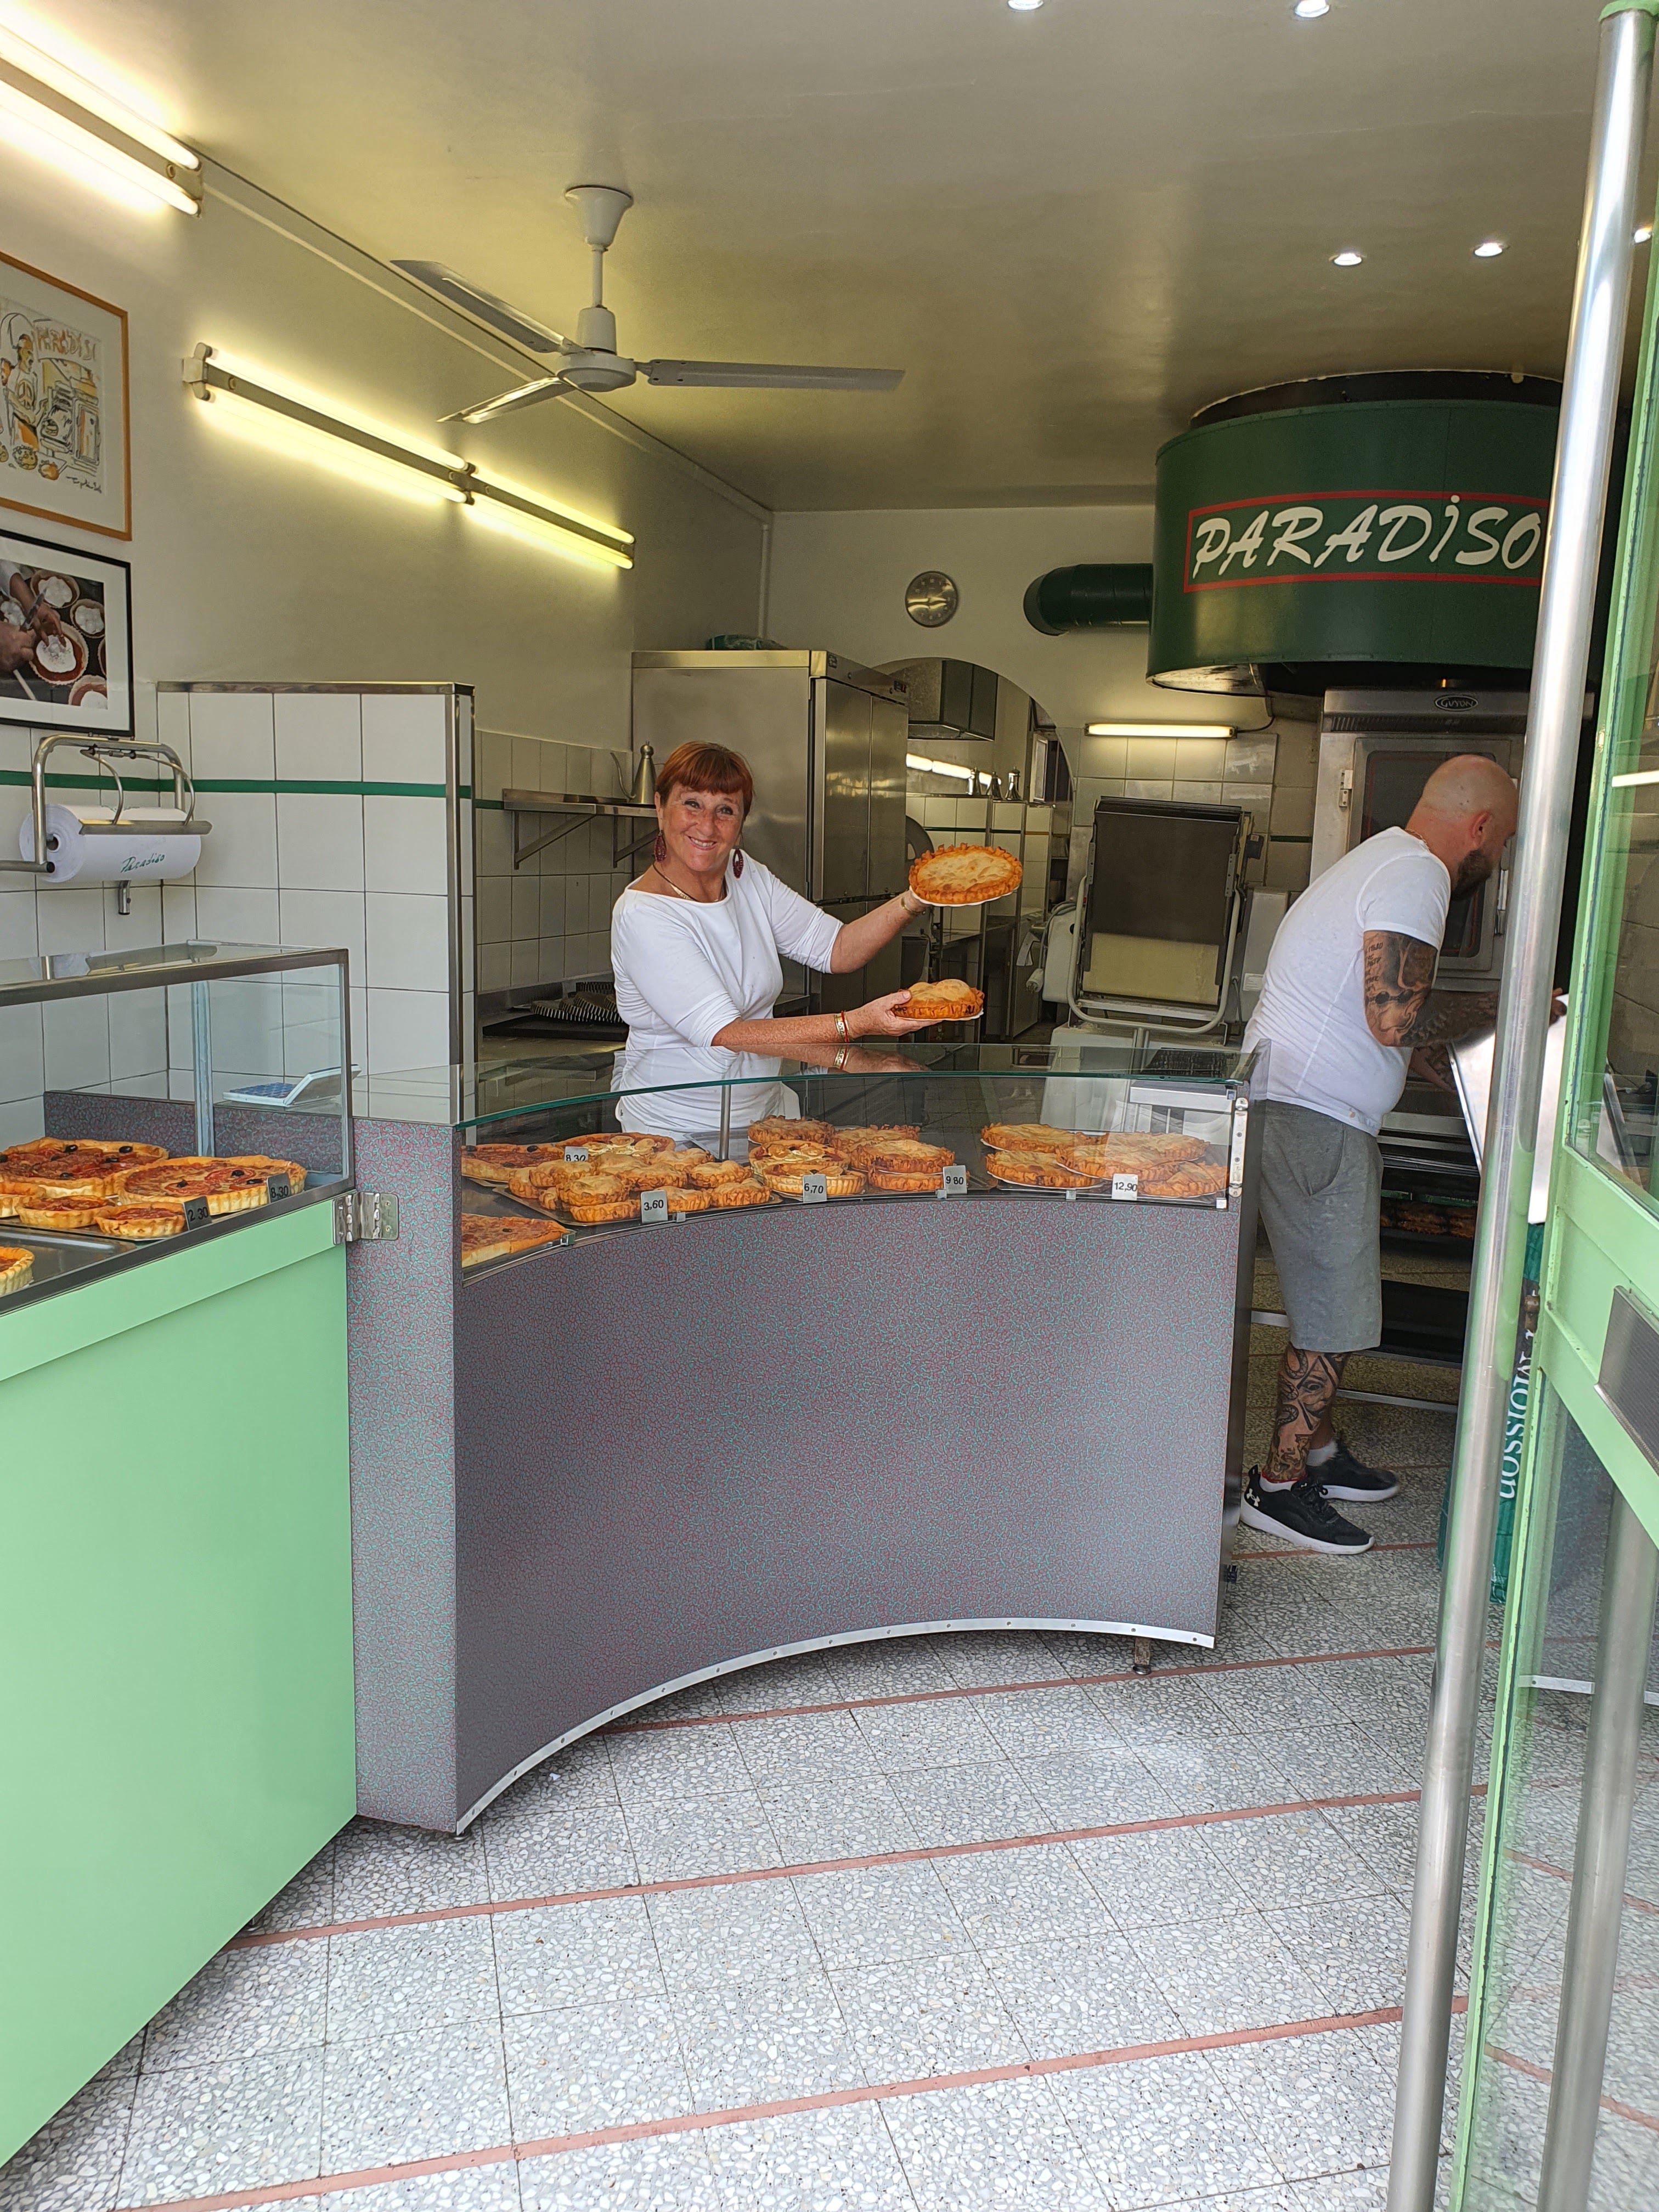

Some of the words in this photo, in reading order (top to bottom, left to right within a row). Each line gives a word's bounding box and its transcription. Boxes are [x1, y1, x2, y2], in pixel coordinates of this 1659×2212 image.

[120, 853, 166, 873] Paradiso
[804, 1183, 824, 1194] 6,70
[1114, 1182, 1137, 1192] 12,90
[644, 1199, 664, 1211] 3,60
